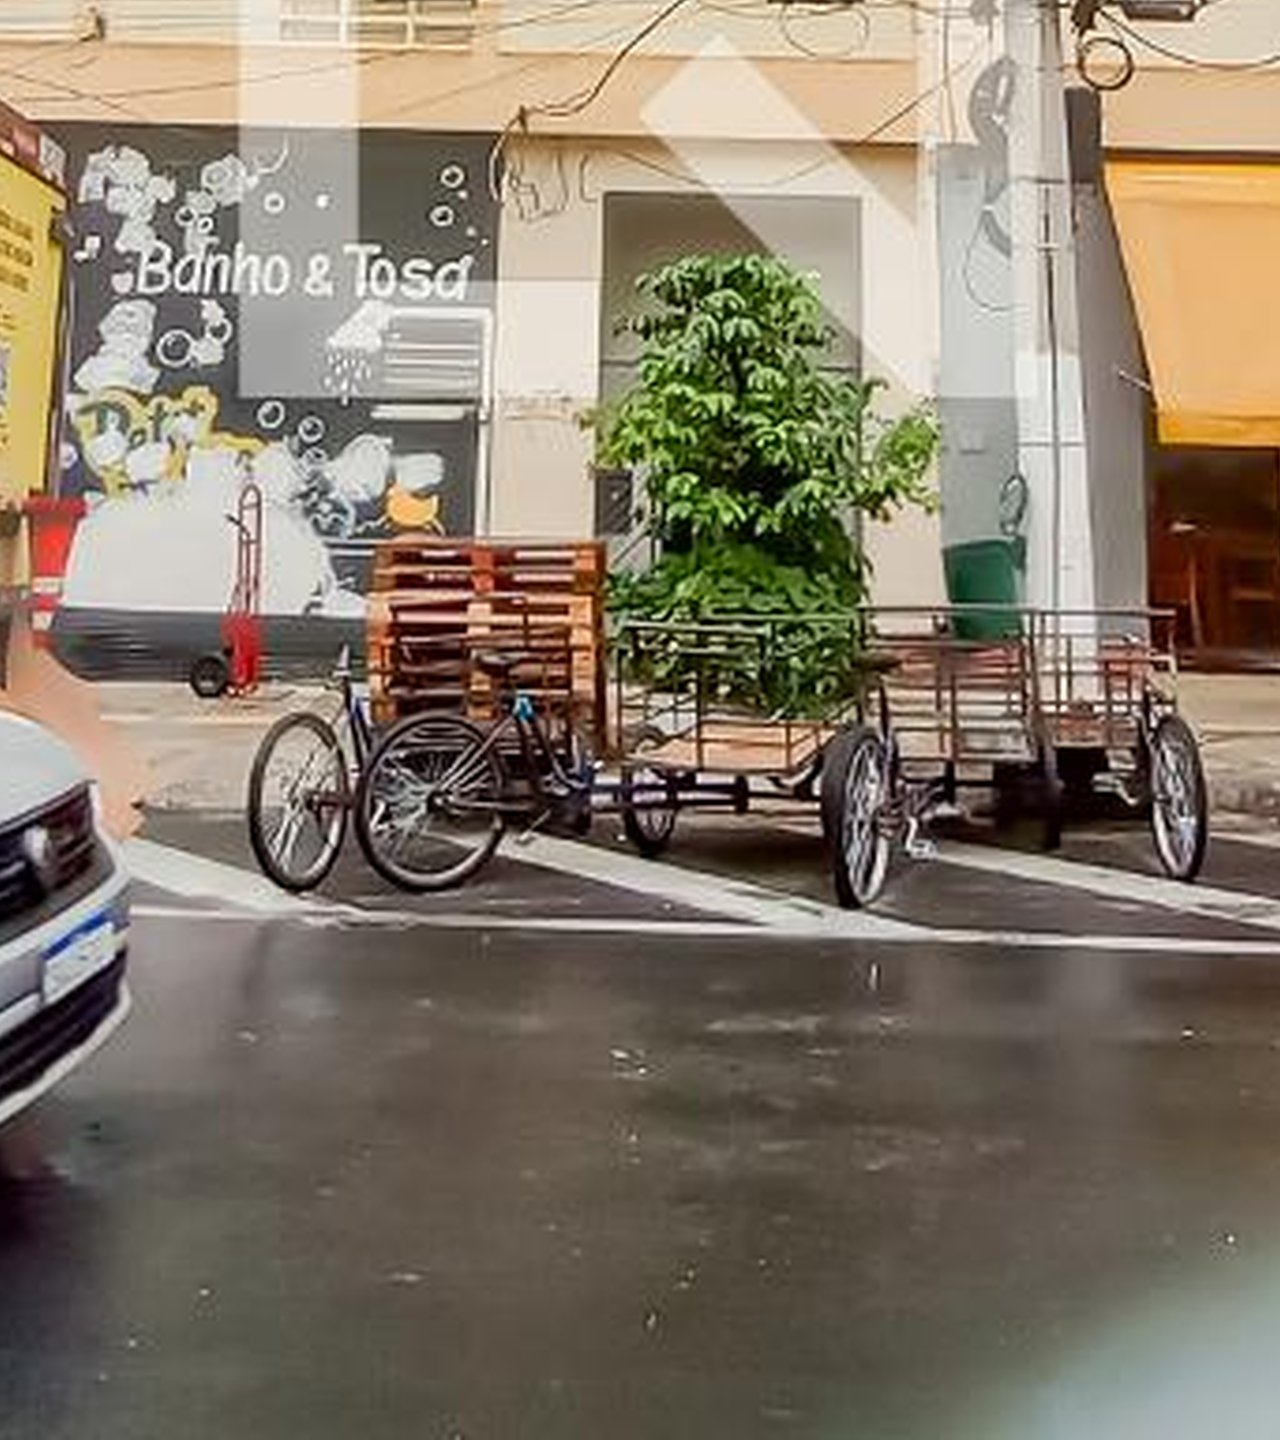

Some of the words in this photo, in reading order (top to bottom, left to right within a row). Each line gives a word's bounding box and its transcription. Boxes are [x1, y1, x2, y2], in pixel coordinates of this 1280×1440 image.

[136, 241, 291, 296] Banho
[304, 252, 335, 298] &
[343, 243, 474, 301] Tosa
